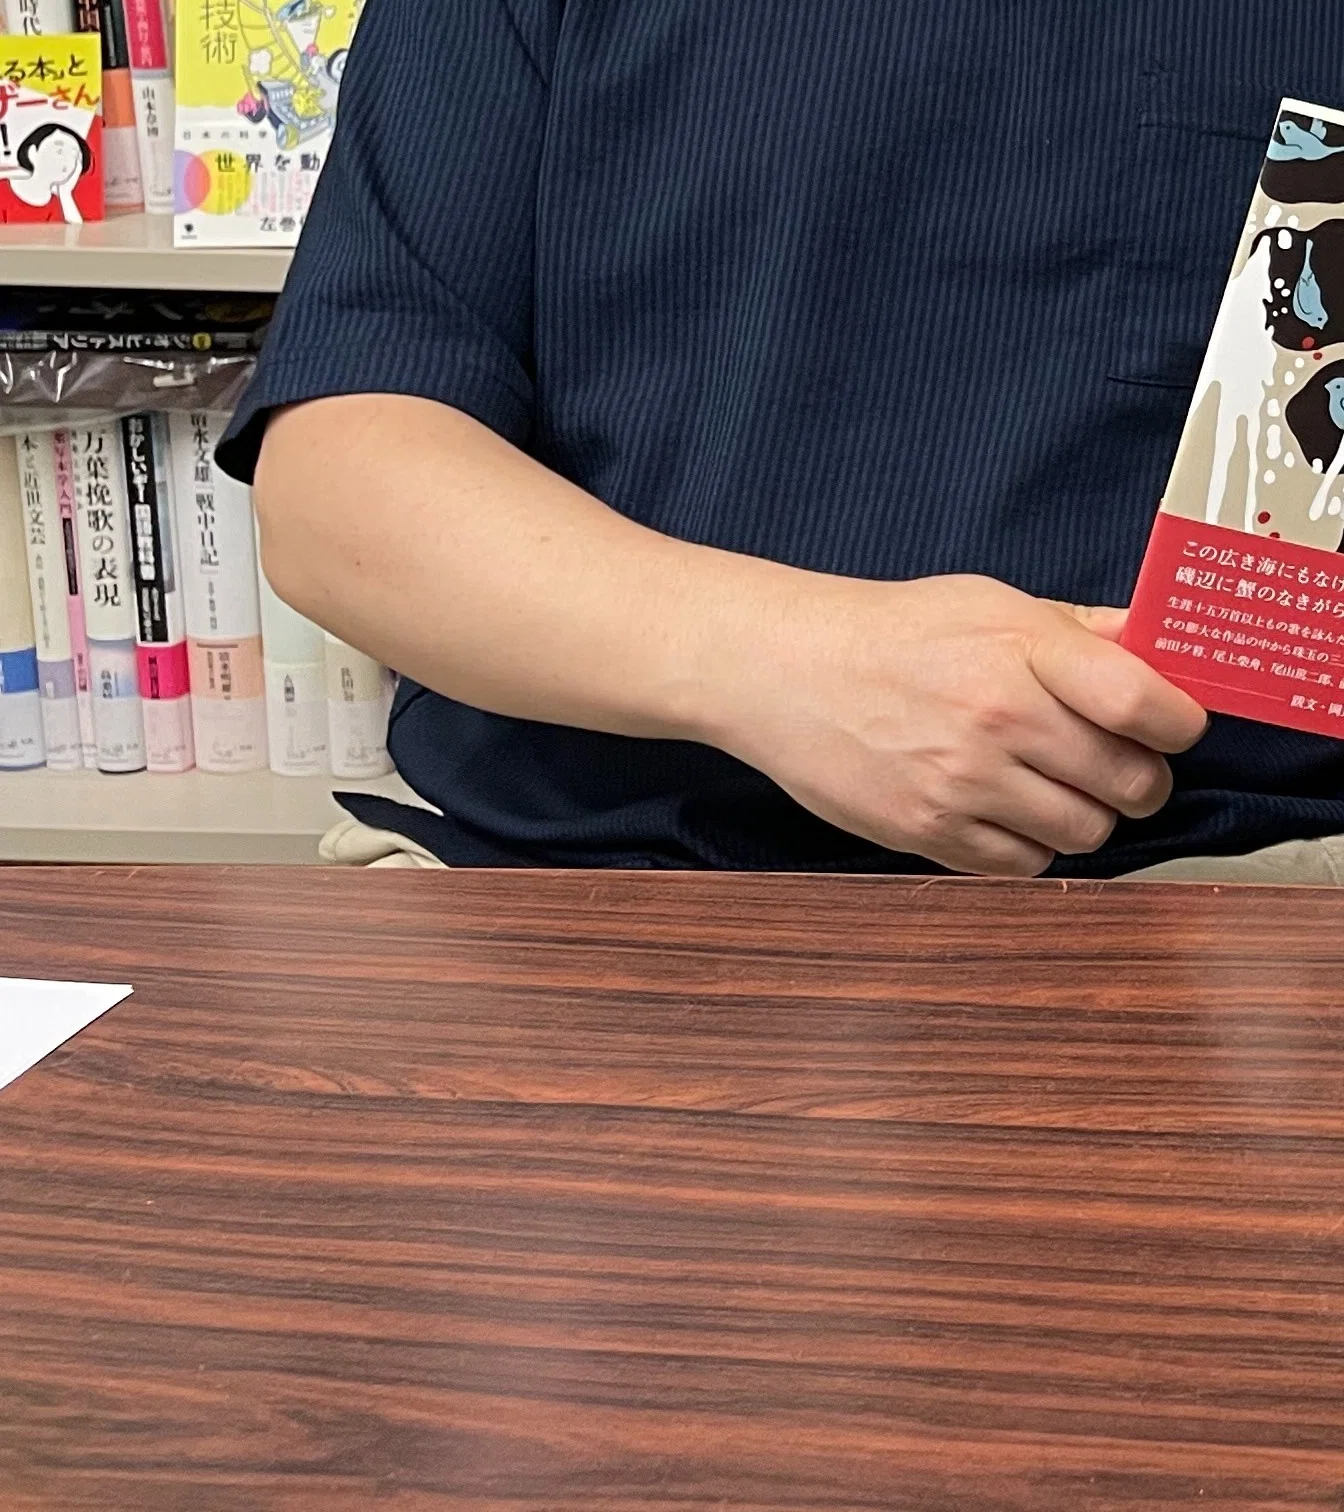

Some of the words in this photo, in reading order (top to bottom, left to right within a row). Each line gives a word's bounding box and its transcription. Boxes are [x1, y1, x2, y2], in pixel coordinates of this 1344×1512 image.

[83, 429, 122, 608] 万葉挽歌の表現
